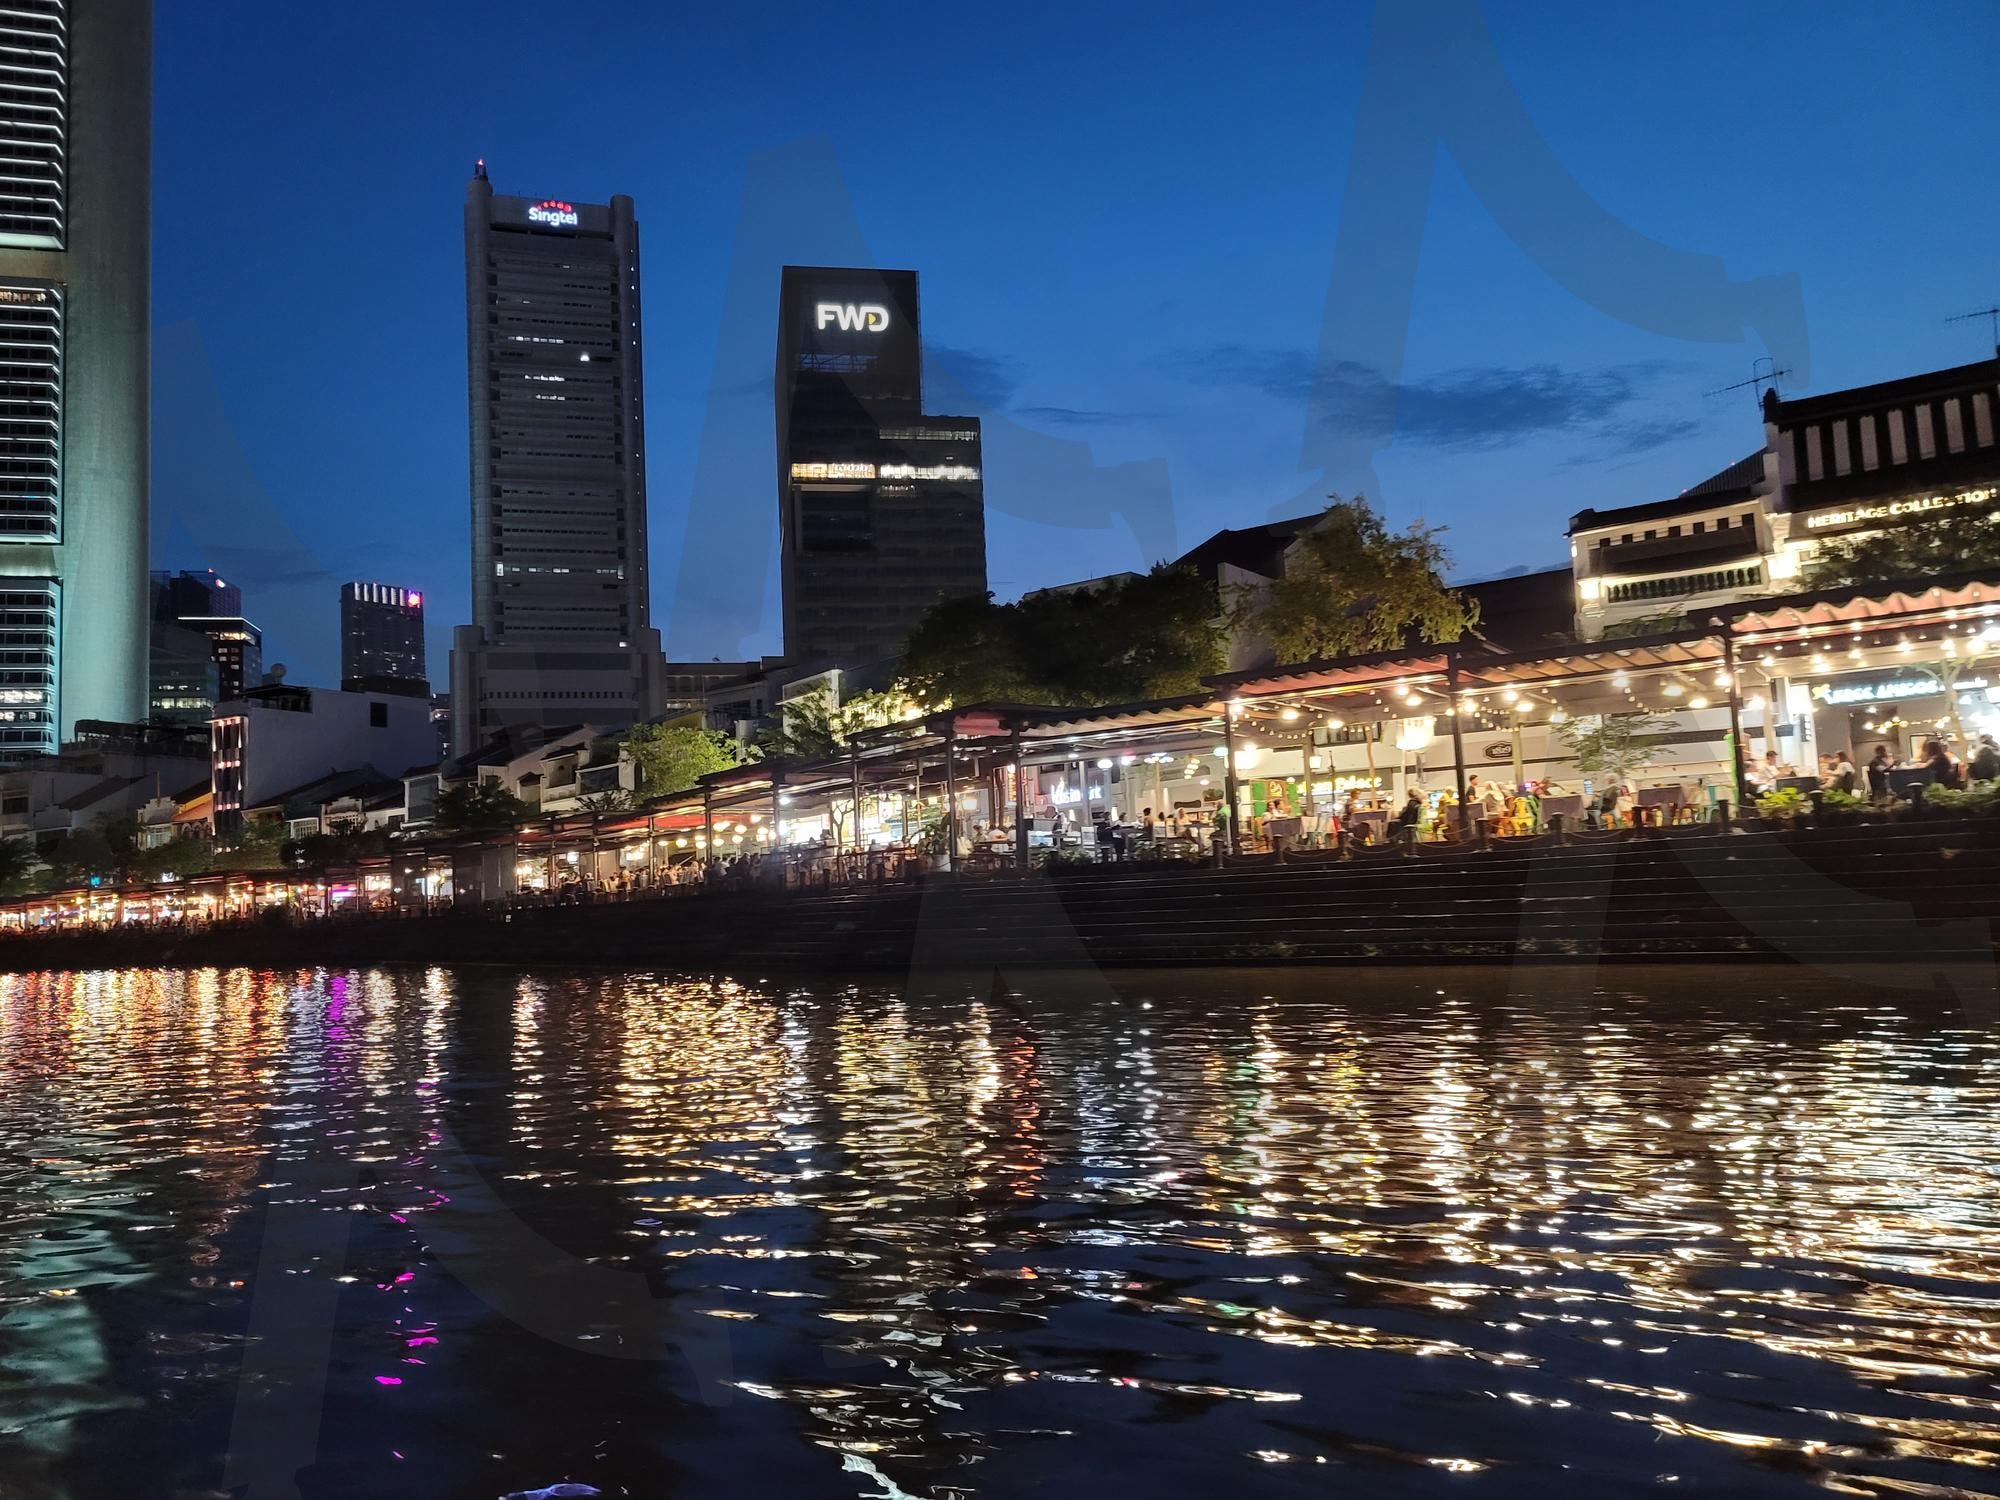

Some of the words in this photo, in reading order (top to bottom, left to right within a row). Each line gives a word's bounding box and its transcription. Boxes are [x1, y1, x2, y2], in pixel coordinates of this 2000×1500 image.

[528, 206, 578, 227] Singtel
[817, 304, 889, 332] FWD
[1807, 506, 1889, 528] HERITAGE
